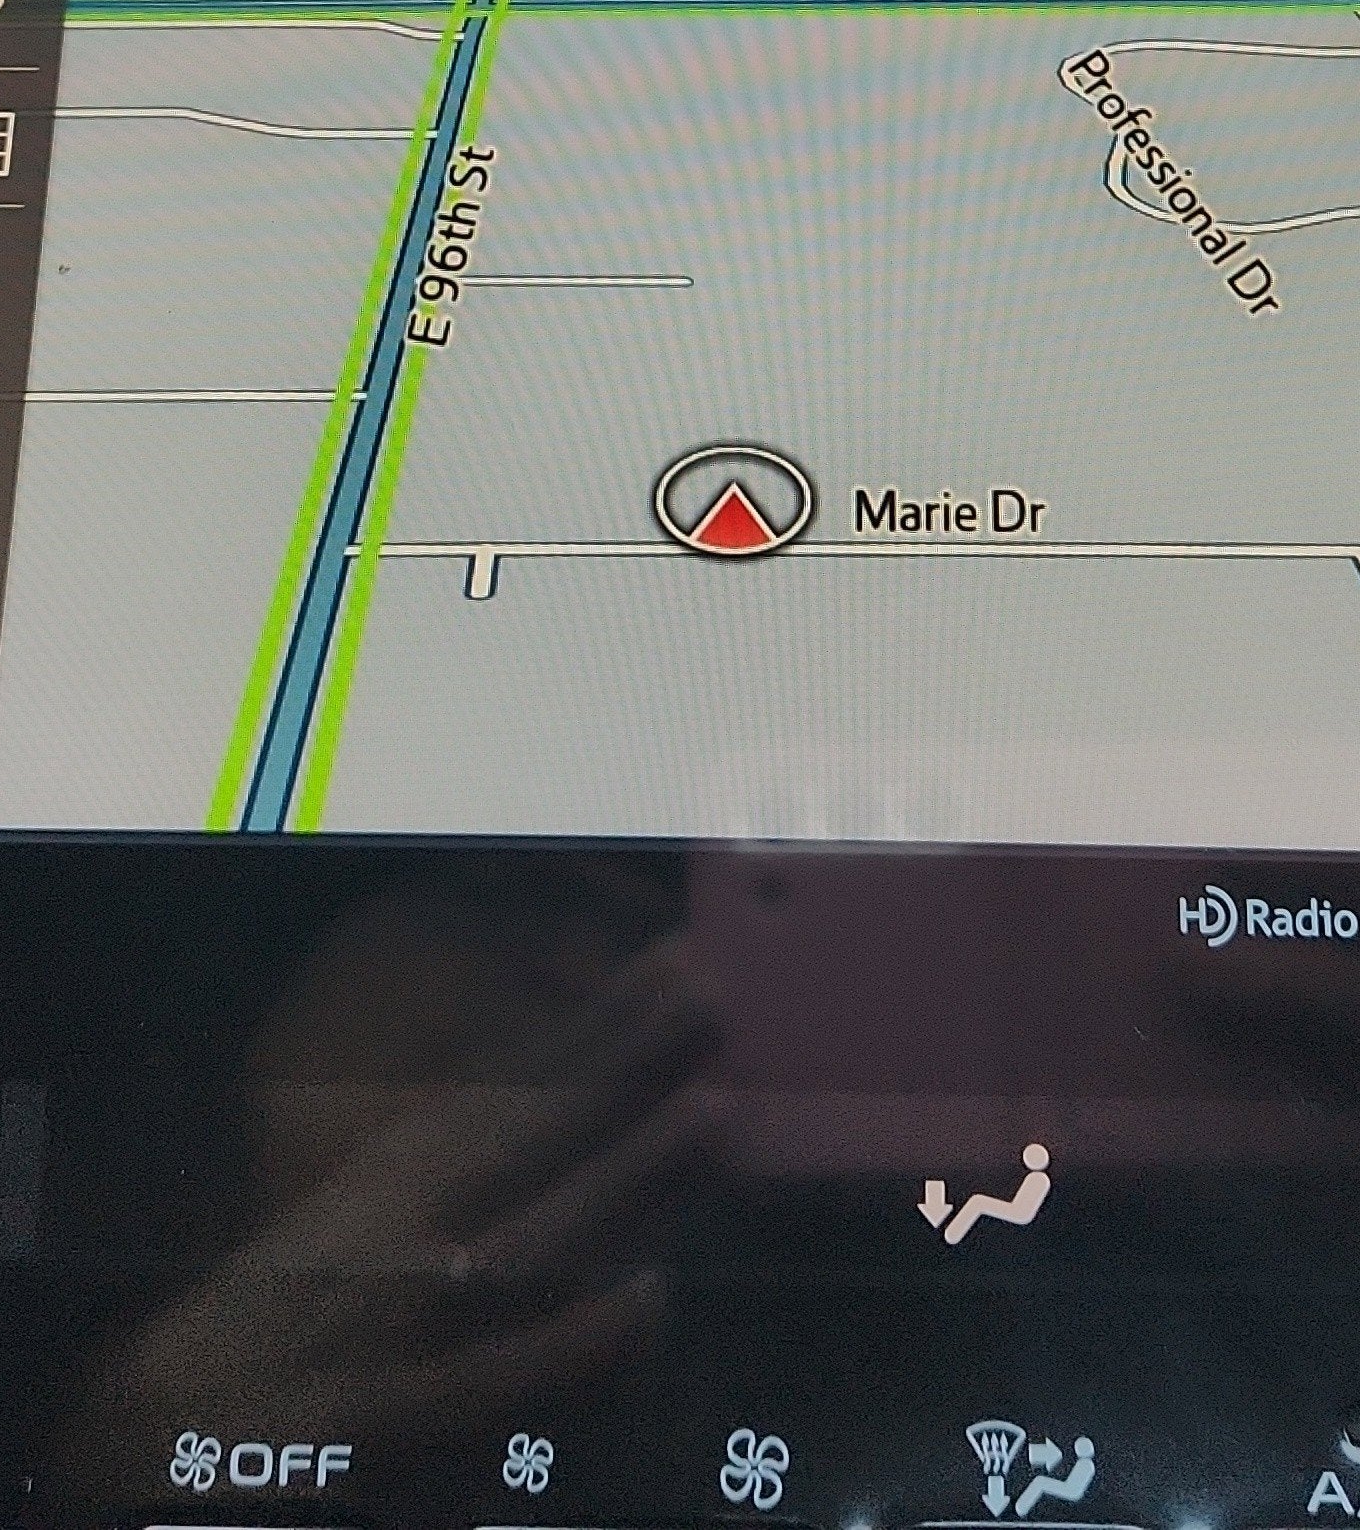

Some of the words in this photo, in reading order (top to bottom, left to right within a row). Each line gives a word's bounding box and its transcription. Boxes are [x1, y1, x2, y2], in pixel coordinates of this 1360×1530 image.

[449, 145, 495, 193] St
[1068, 49, 1247, 265] Professional
[1227, 258, 1280, 315] Dr
[418, 201, 481, 303] 96th
[407, 313, 451, 348] E
[854, 488, 978, 533] Marie
[991, 488, 1046, 533] Dr
[1178, 884, 1238, 949] HD
[1245, 896, 1360, 939] Radio
[228, 1441, 354, 1489] OFF
